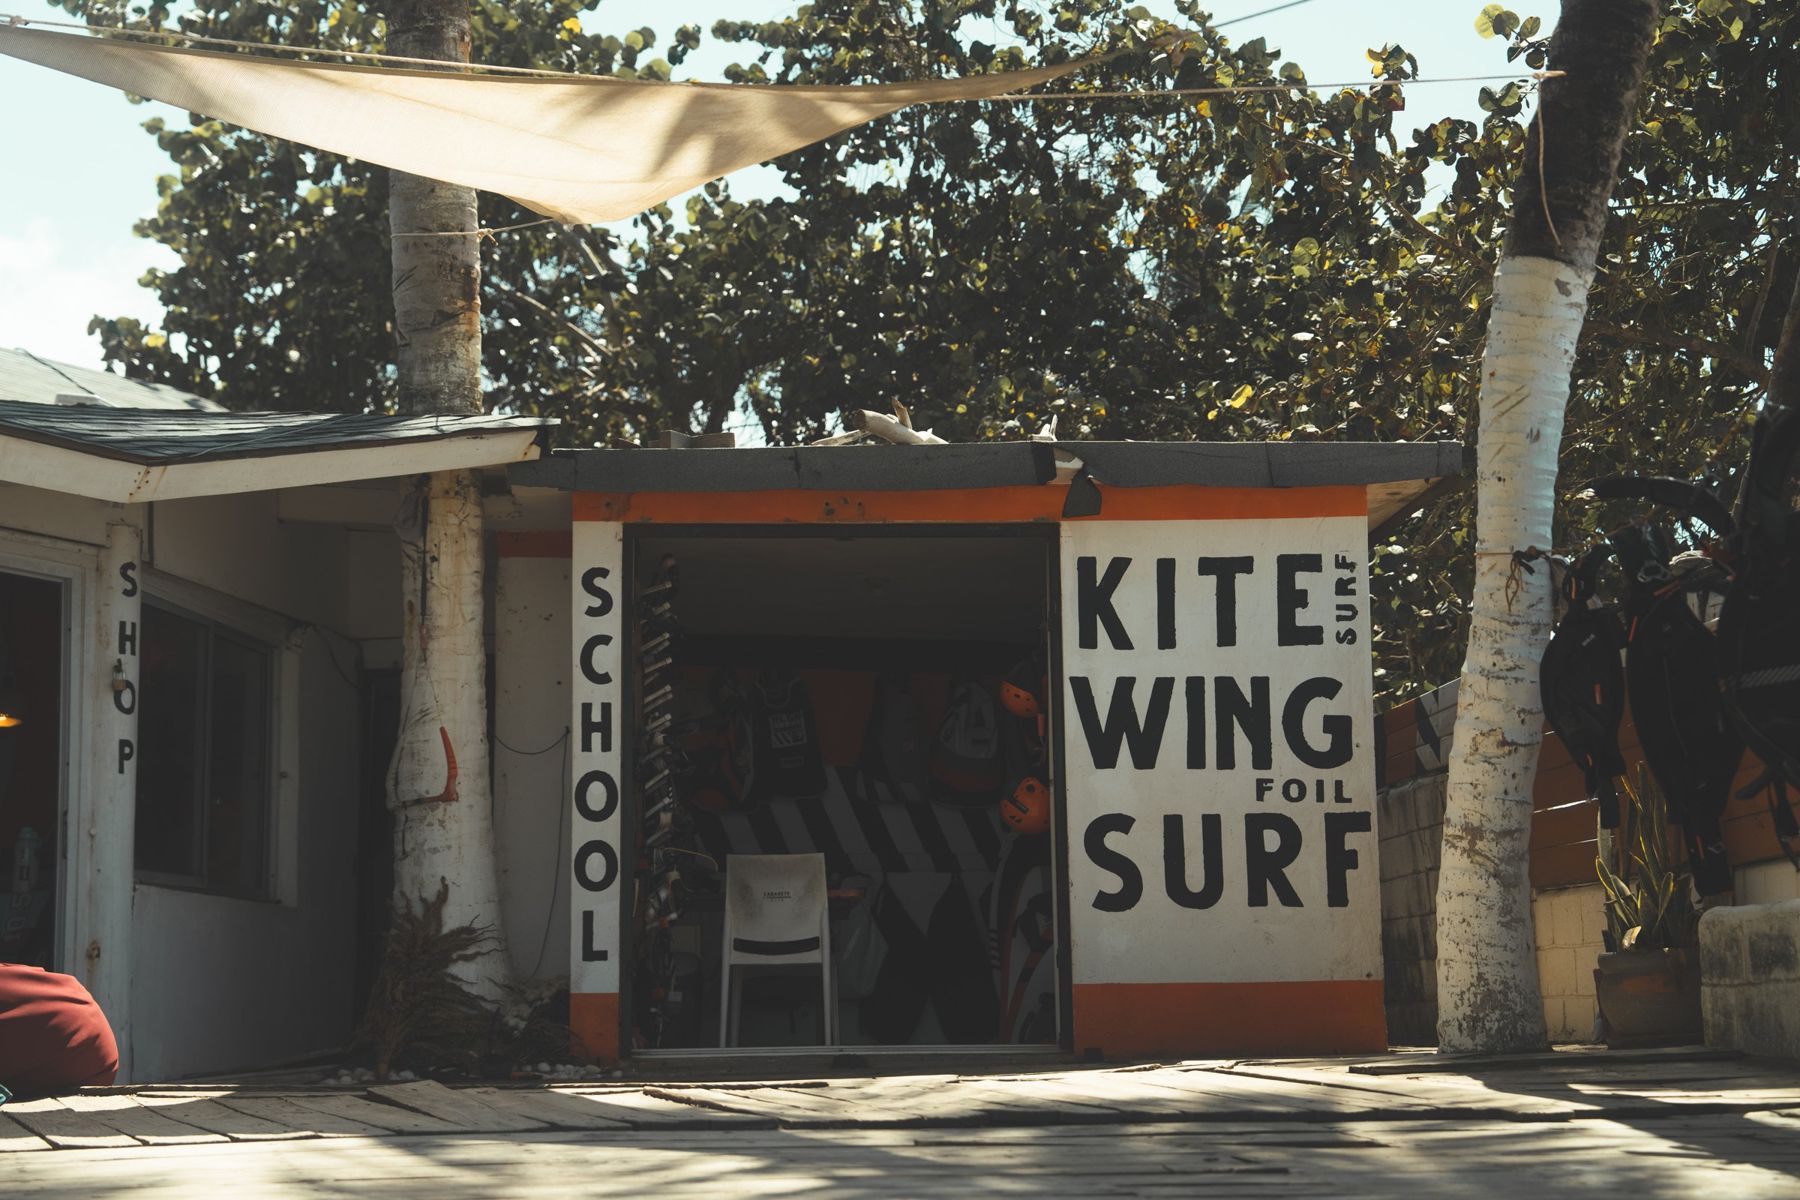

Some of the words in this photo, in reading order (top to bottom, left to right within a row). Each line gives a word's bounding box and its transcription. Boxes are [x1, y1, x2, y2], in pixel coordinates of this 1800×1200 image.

[1077, 554, 1323, 650] KITE
[1335, 553, 1358, 645] SURF
[114, 561, 138, 775] SHOP
[574, 567, 618, 962] SCHOOL
[1069, 676, 1353, 770] WING
[1256, 778, 1353, 803] FOIL
[1084, 811, 1371, 912] SURF
